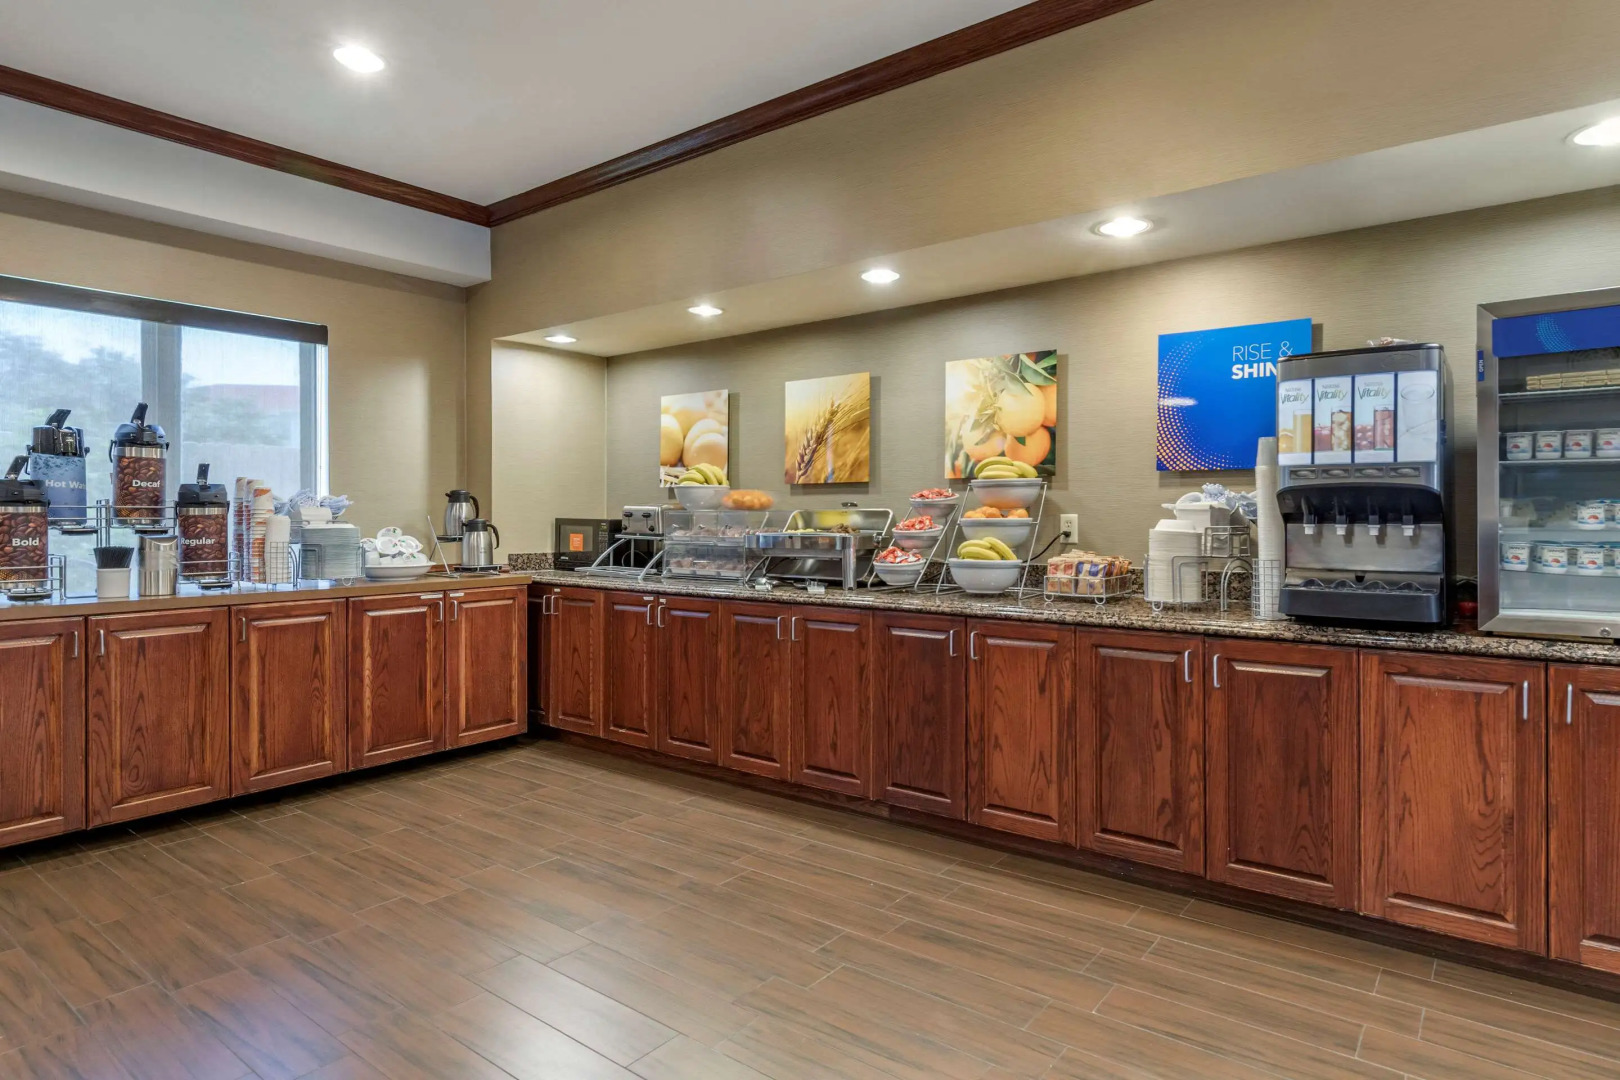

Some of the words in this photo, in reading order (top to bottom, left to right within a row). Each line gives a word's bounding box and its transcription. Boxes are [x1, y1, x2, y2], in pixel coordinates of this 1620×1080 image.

[1232, 342, 1272, 361] RISE
[1278, 340, 1293, 357] &
[1280, 392, 1309, 405] Vitality
[1316, 387, 1348, 402] Vitality
[1357, 385, 1391, 400] Vitality
[45, 479, 67, 488] Hot
[132, 479, 161, 488] Decaf
[12, 537, 39, 547] Bold
[180, 536, 216, 547] Regular
